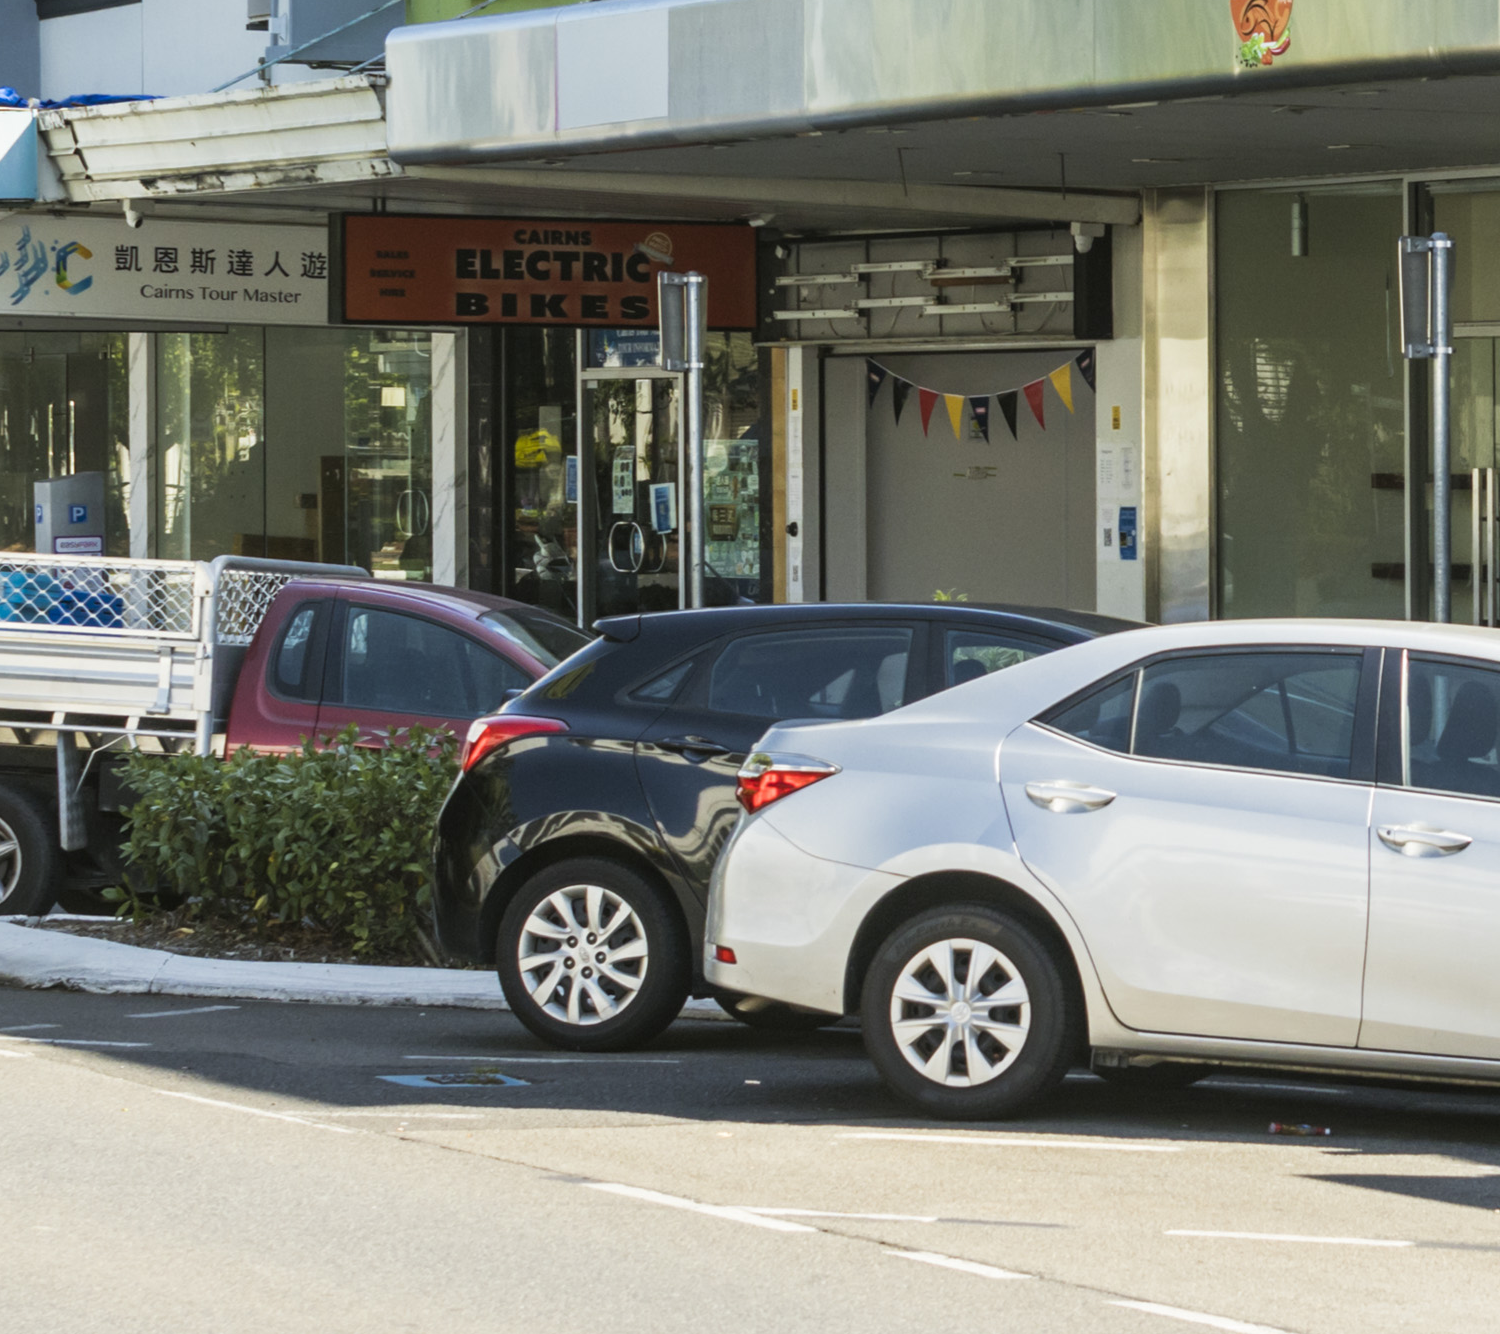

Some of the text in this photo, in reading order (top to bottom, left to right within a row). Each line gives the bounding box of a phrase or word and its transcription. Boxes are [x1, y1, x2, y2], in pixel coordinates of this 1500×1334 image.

[513, 229, 592, 246] CAIRNS
[114, 244, 328, 280] 凱恩斯達人遊
[455, 248, 651, 284] ELECTRIC
[139, 284, 302, 303] Cairns Tour Master
[455, 292, 651, 320] BIKES
[72, 507, 84, 521] P
